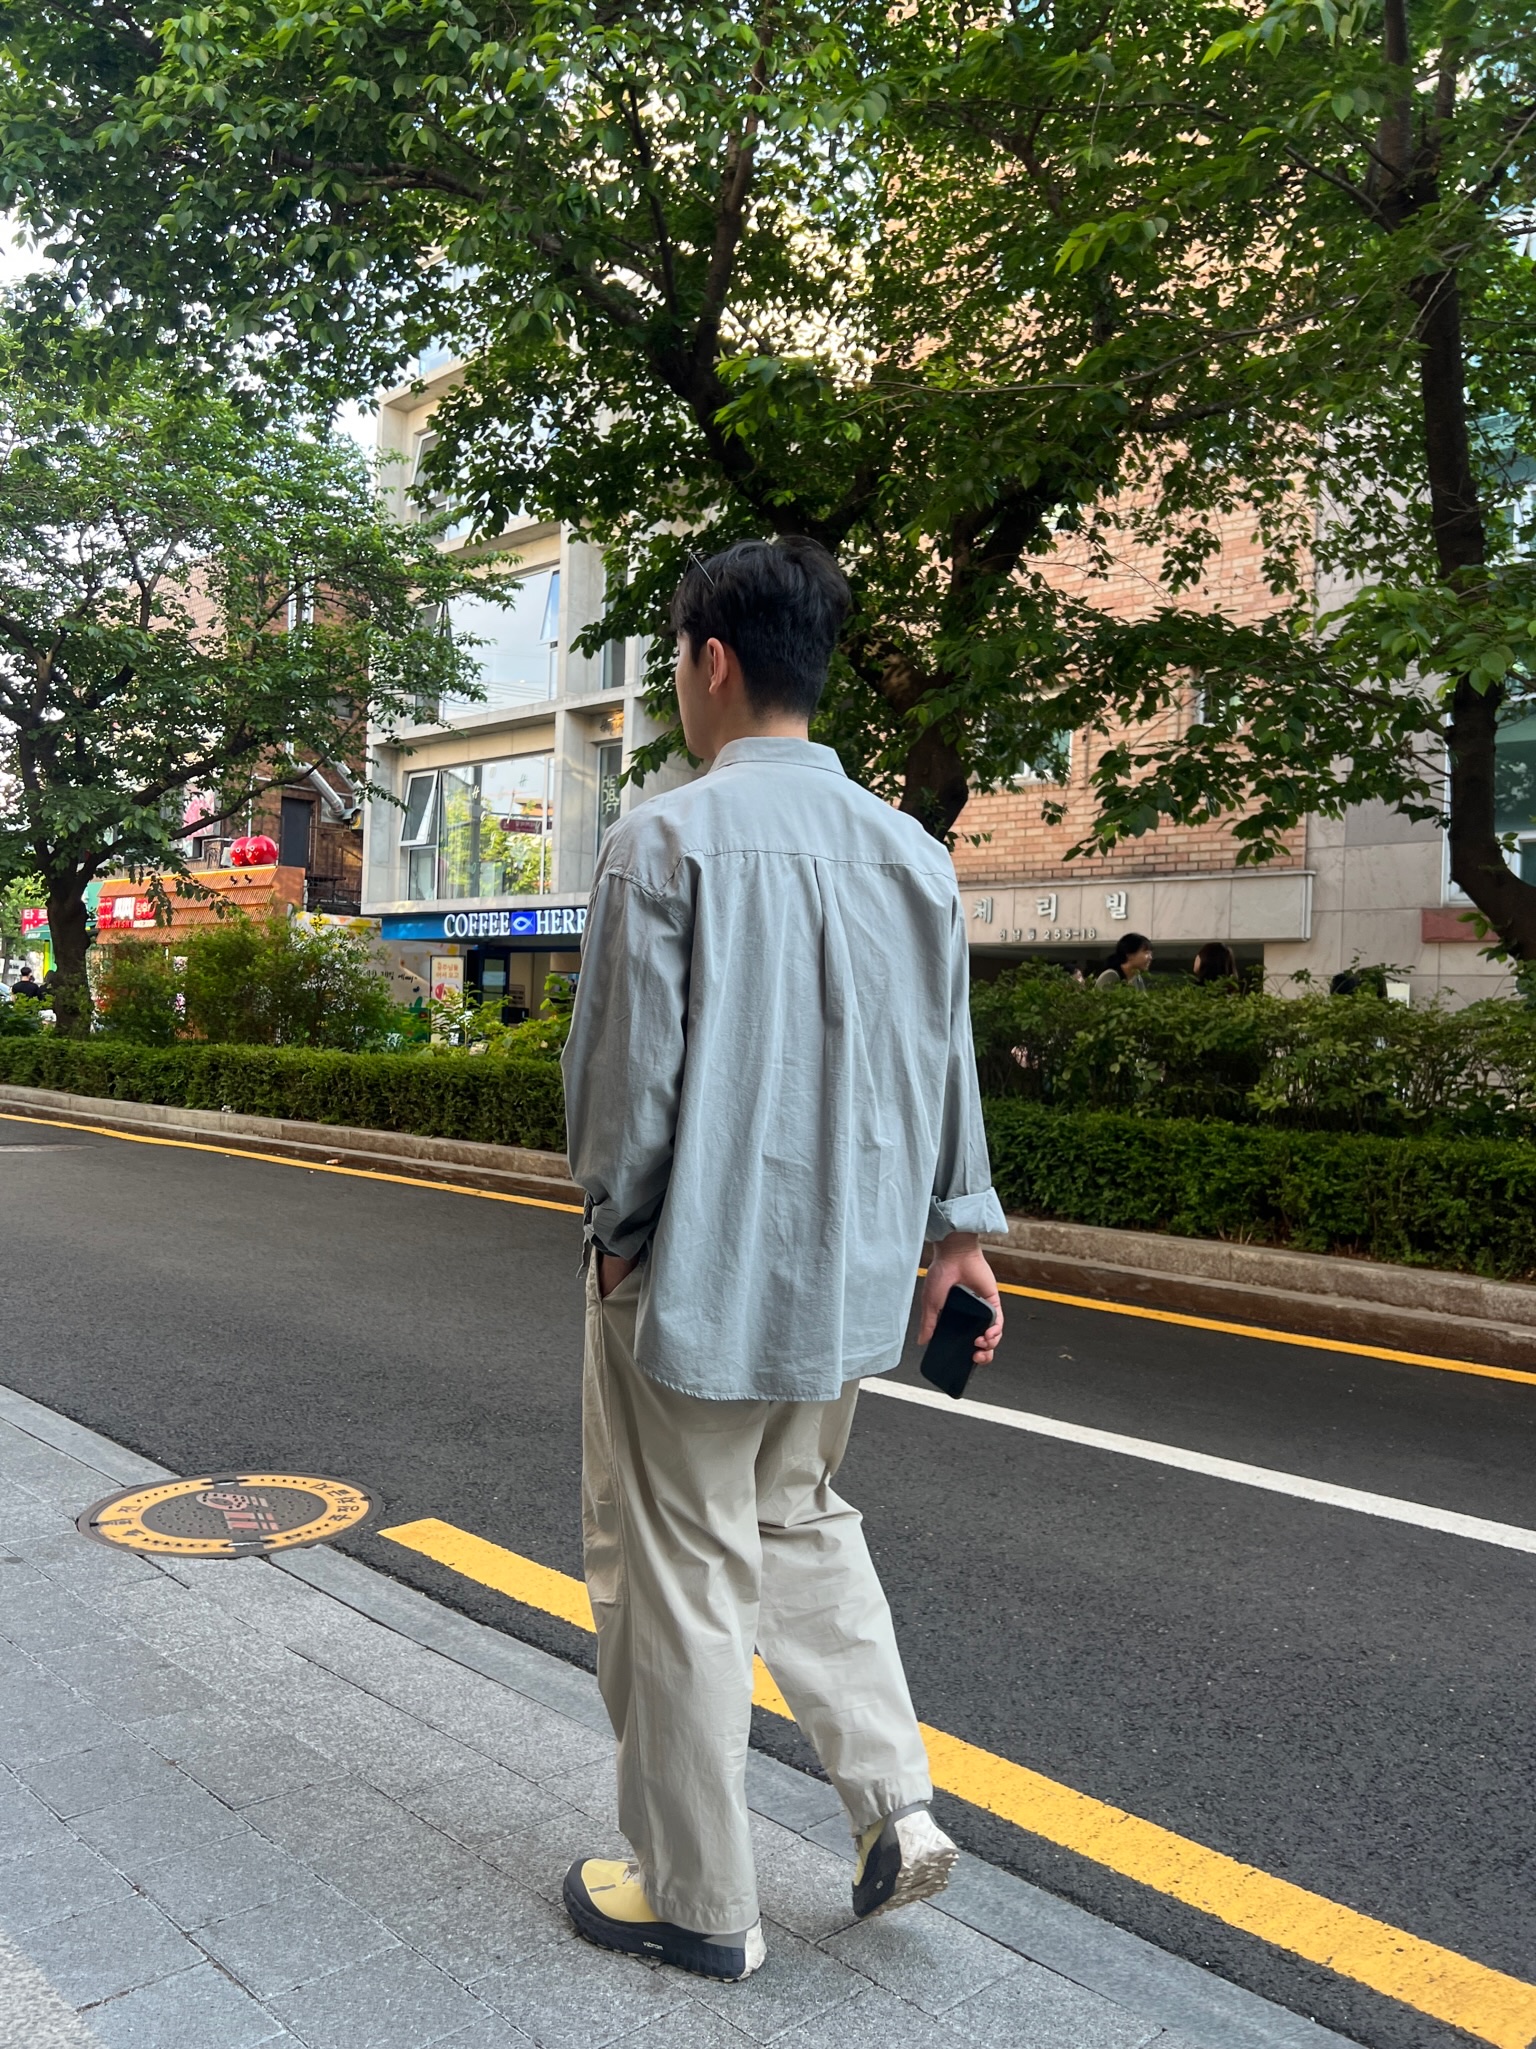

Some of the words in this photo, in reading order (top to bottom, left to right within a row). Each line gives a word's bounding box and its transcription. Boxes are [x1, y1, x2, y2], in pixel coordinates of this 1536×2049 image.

[445, 912, 511, 936] COFFEE
[536, 909, 587, 935] HERR
[1043, 928, 1097, 941] 255-18
[310, 1481, 362, 1523] 주정차금지
[103, 1505, 144, 1537] 소화전
